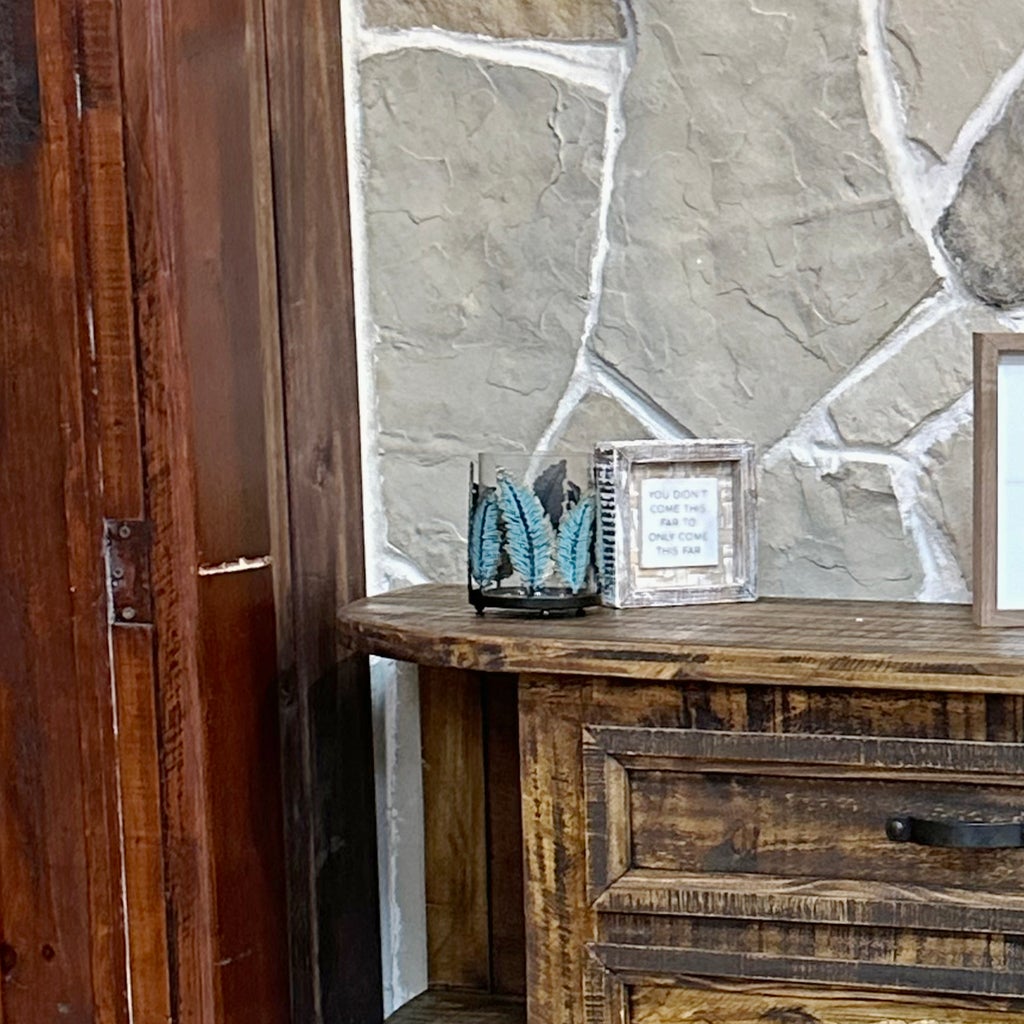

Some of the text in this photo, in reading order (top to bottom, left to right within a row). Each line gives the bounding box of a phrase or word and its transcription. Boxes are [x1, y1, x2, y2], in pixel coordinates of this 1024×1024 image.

[648, 489, 670, 500] YOU
[649, 503, 707, 514] COME THIS
[659, 518, 697, 527] FAR TO
[647, 532, 708, 542] ONLY COME
[656, 546, 702, 556] THIS FAR
